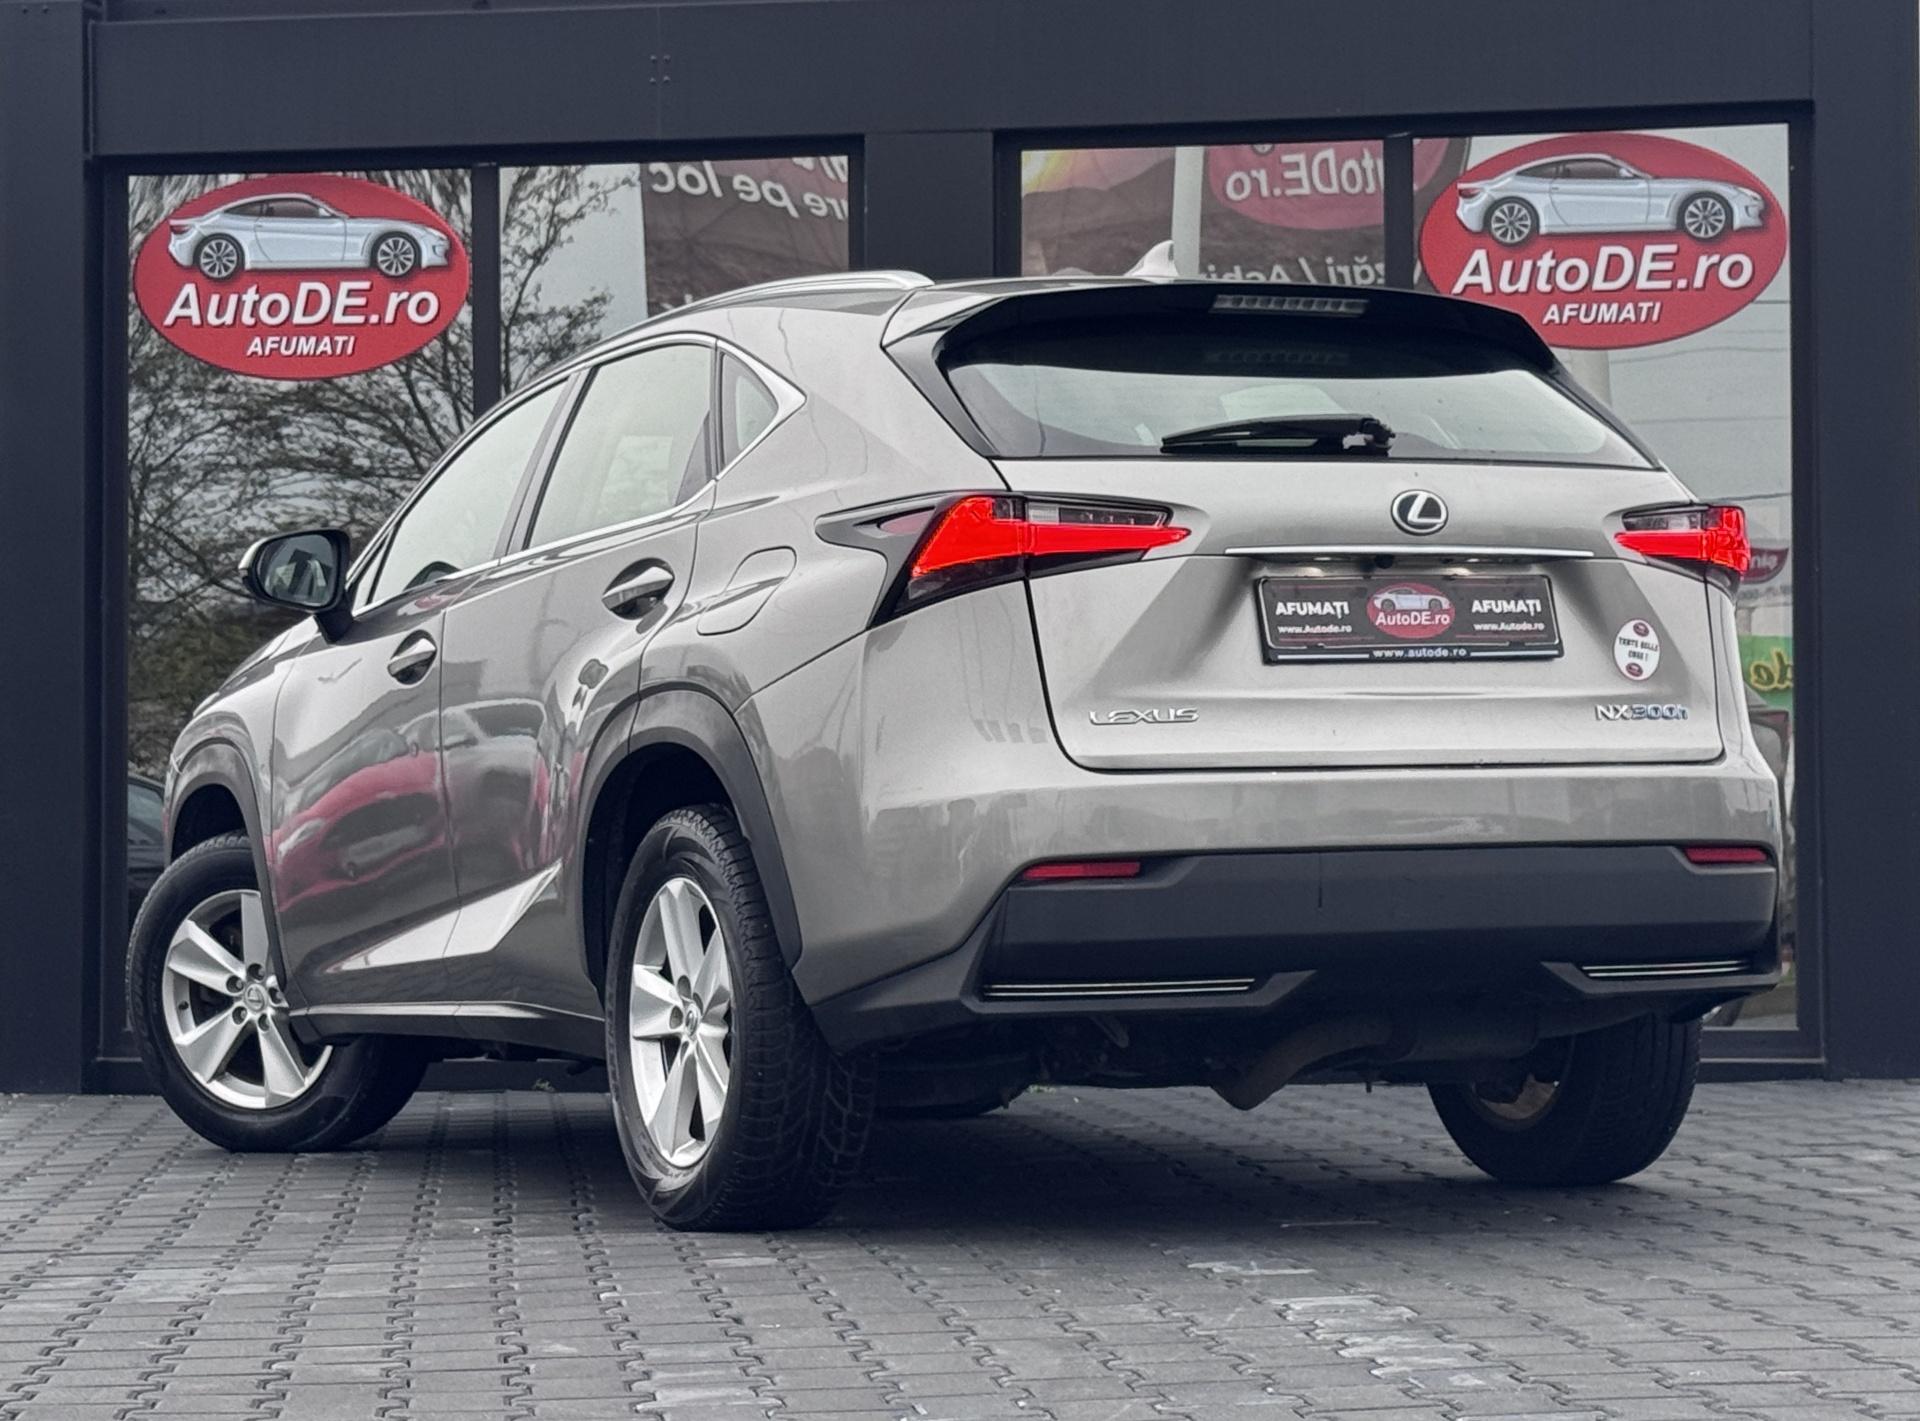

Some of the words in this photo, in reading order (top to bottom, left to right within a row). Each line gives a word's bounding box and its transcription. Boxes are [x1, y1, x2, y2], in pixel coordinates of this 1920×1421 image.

[1451, 244, 1753, 295] AutoDE.ro
[163, 281, 440, 327] AutoDE.ro
[1542, 302, 1662, 325] AFUMATI
[246, 335, 357, 357] AFUMATI
[1375, 611, 1450, 626] AutoDE.ro
[1373, 648, 1467, 658] www.autode.ro
[1089, 708, 1199, 726] LEXUS
[1595, 704, 1688, 720] NX300h
